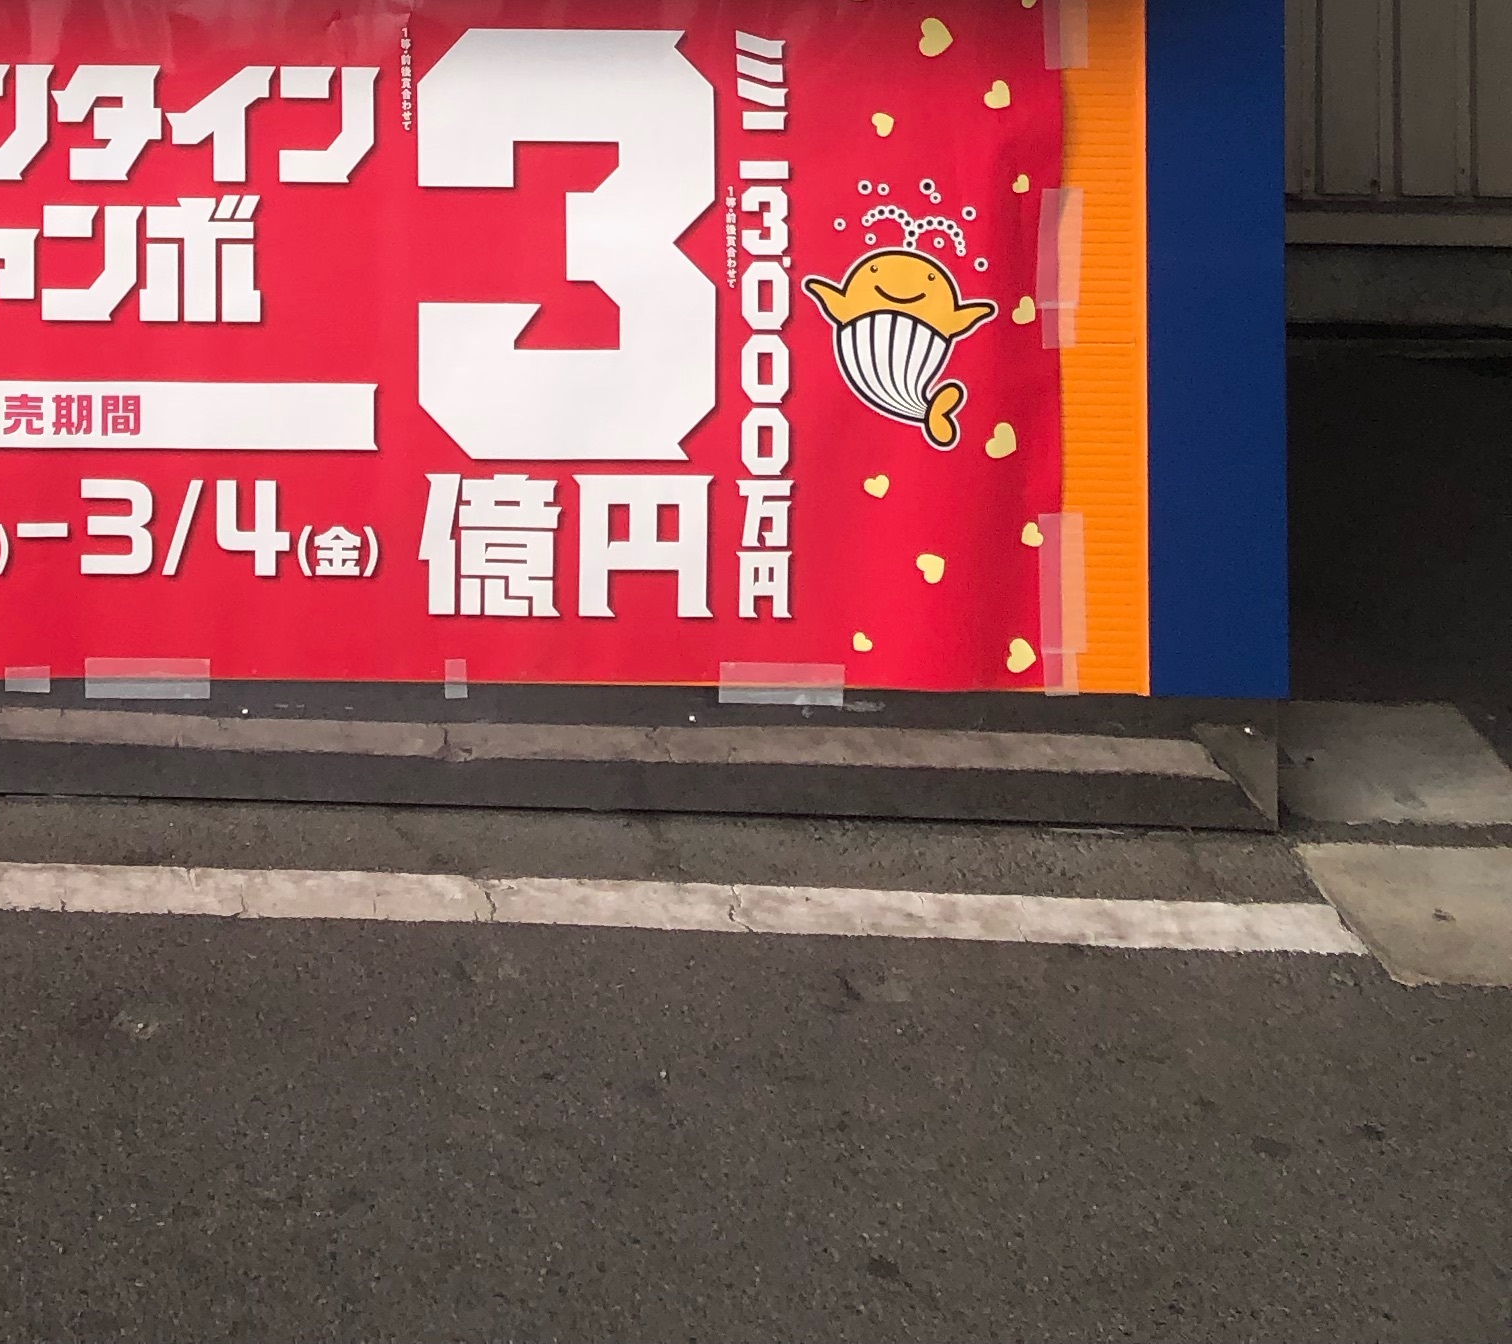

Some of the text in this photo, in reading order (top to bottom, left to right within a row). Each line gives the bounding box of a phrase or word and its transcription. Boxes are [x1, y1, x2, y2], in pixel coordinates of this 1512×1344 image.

[400, 26, 413, 132] 1等・前後賞合わせて
[417, 28, 716, 461] 3
[726, 185, 737, 289] 1等・前後賞合わせて
[417, 472, 716, 618] 億円
